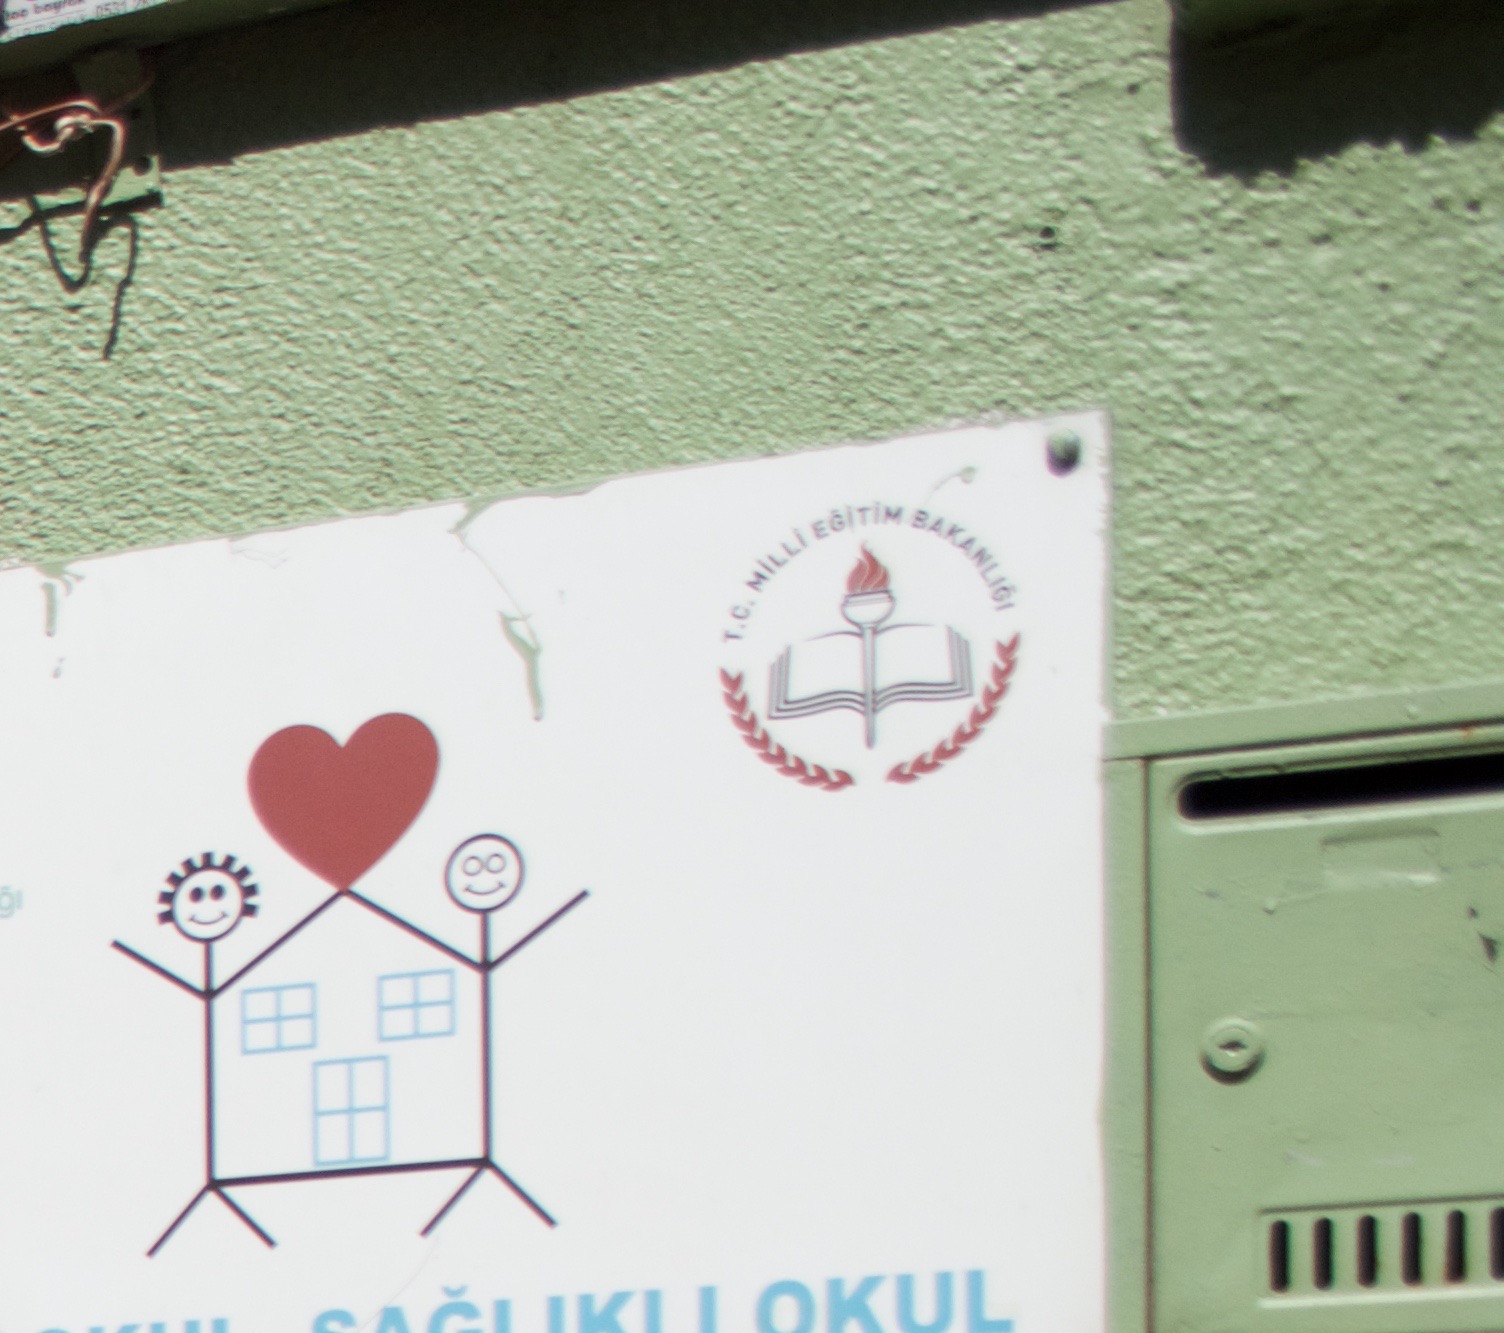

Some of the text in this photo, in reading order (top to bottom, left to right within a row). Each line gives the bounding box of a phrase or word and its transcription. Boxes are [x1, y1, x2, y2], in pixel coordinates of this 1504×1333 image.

[722, 502, 1016, 642] T.C. MİLLİ EĞİTİM BAKANLIĞI
